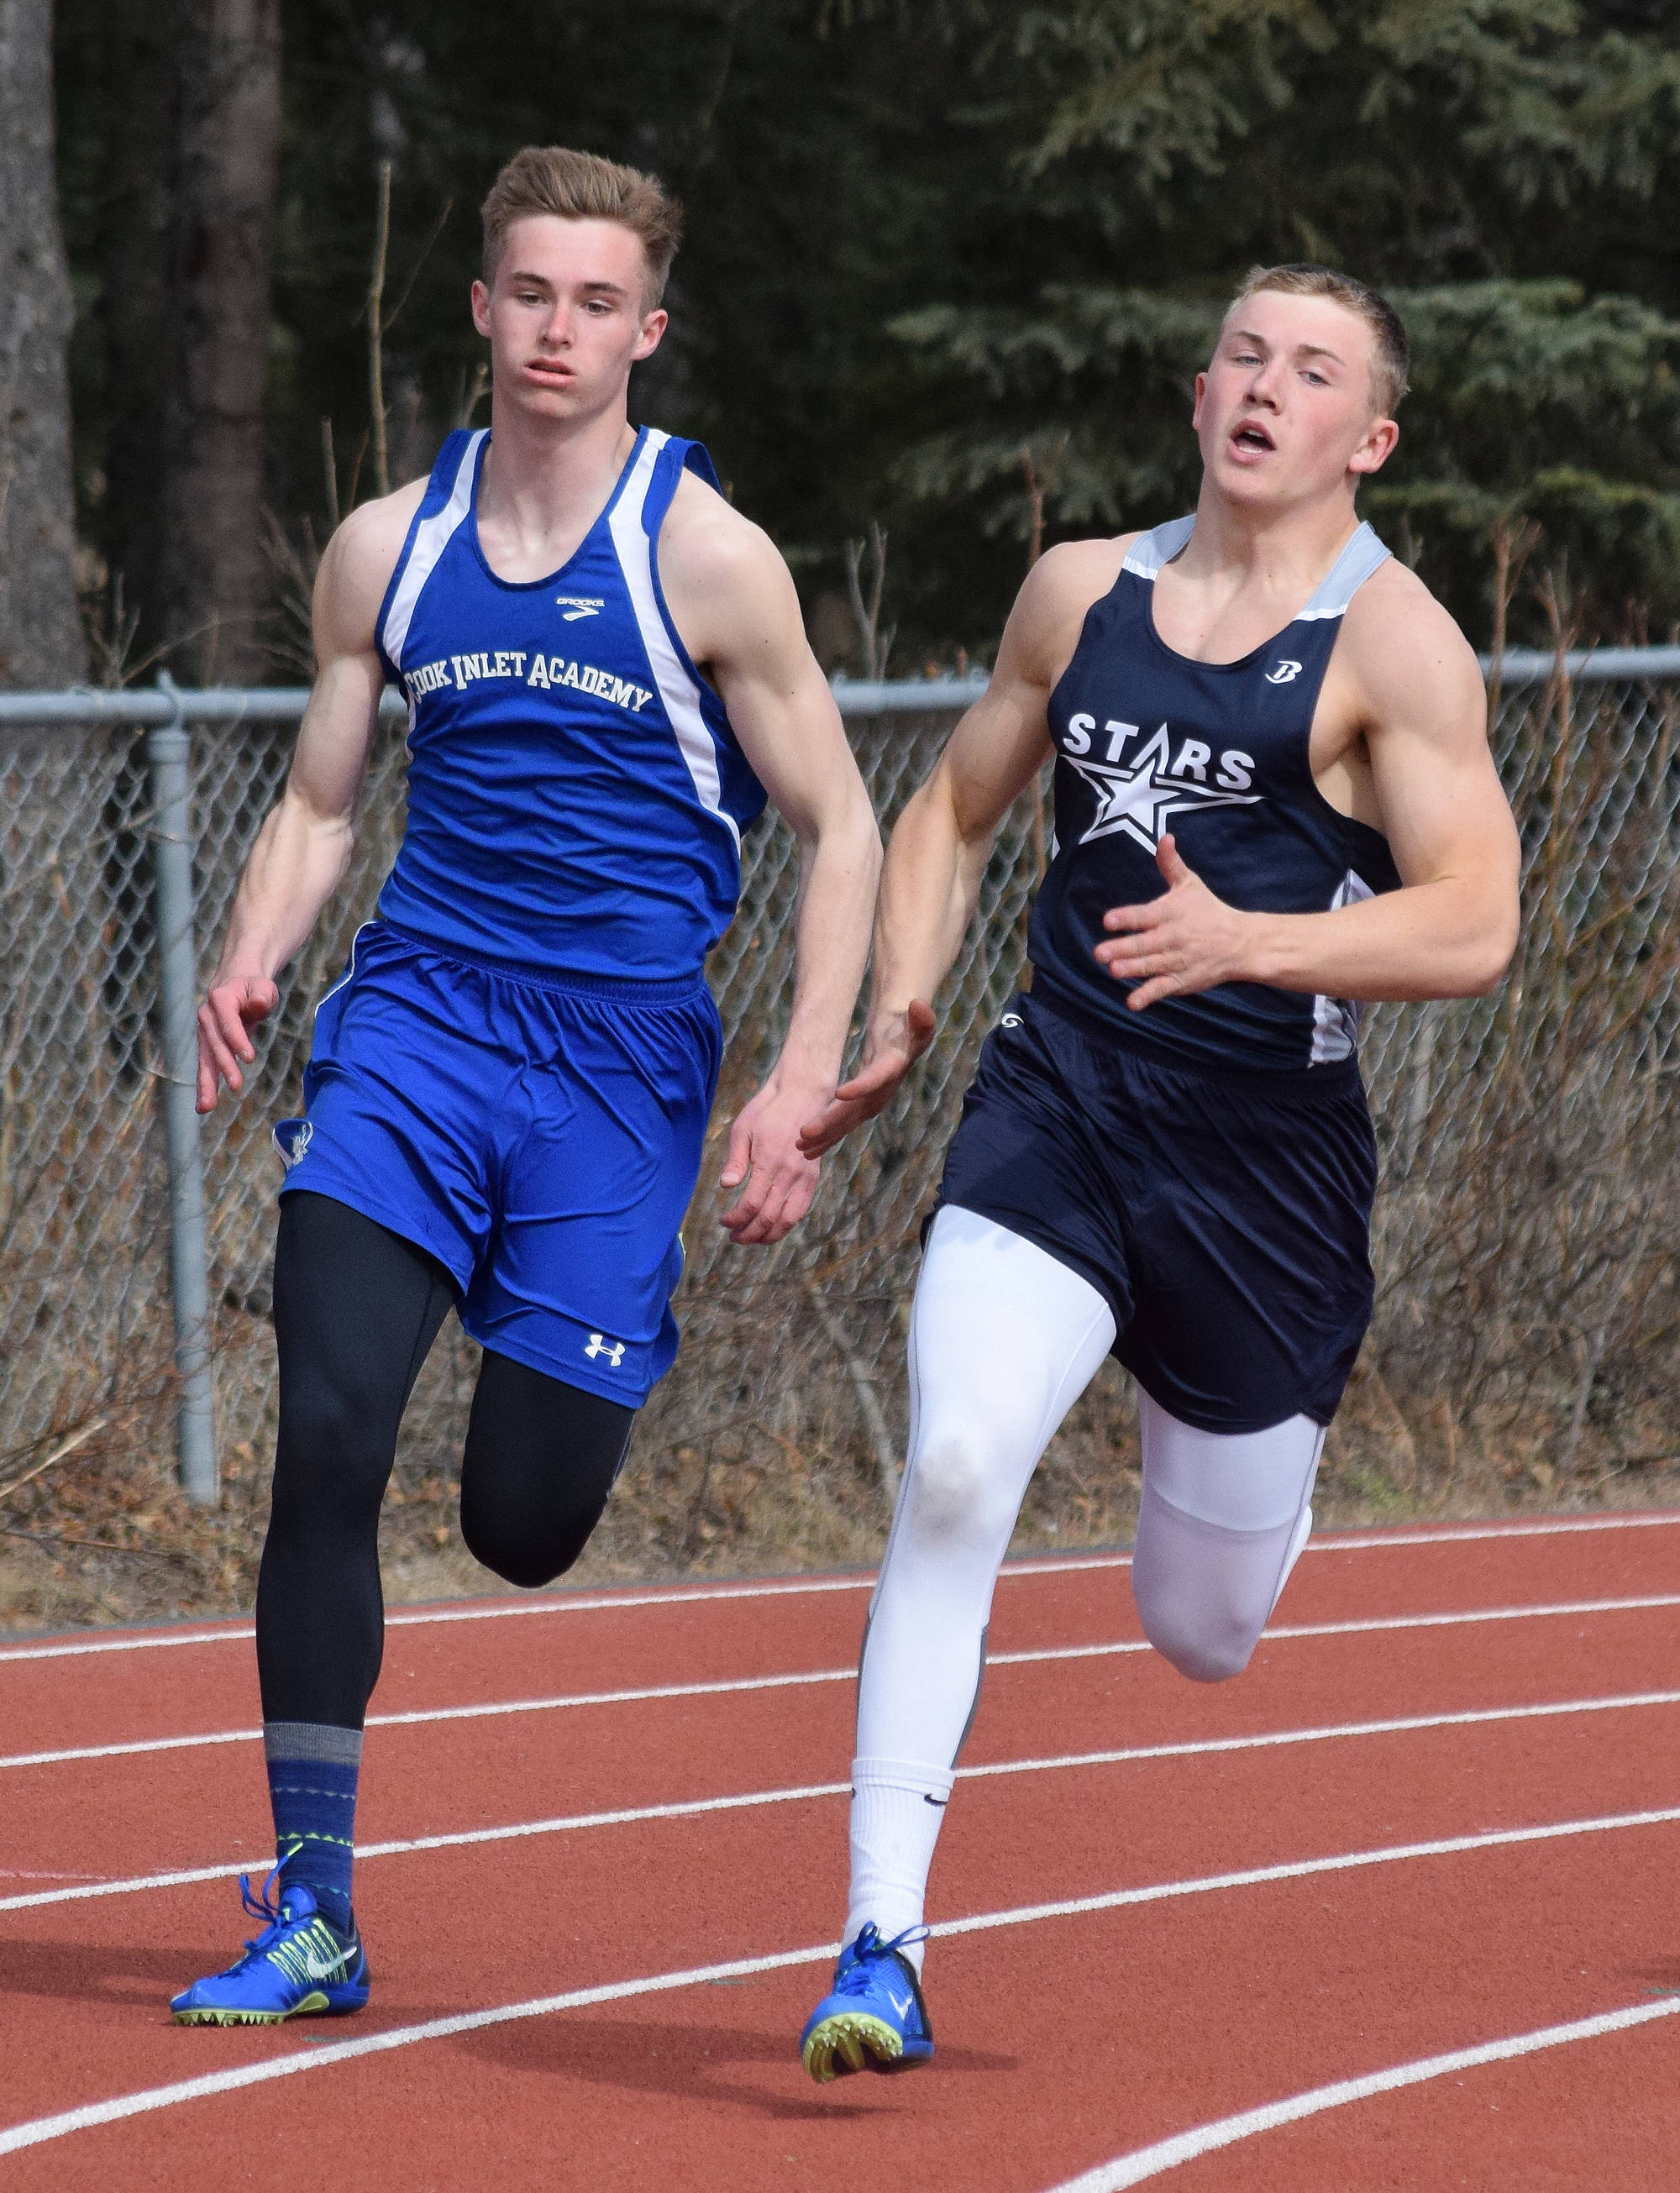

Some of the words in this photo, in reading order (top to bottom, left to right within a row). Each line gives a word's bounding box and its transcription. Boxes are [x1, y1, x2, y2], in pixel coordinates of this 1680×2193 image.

[556, 597, 605, 606] BROOKS
[451, 652, 527, 690] INLET
[528, 654, 653, 712] ACADEMY
[1063, 713, 1255, 790] STARS
